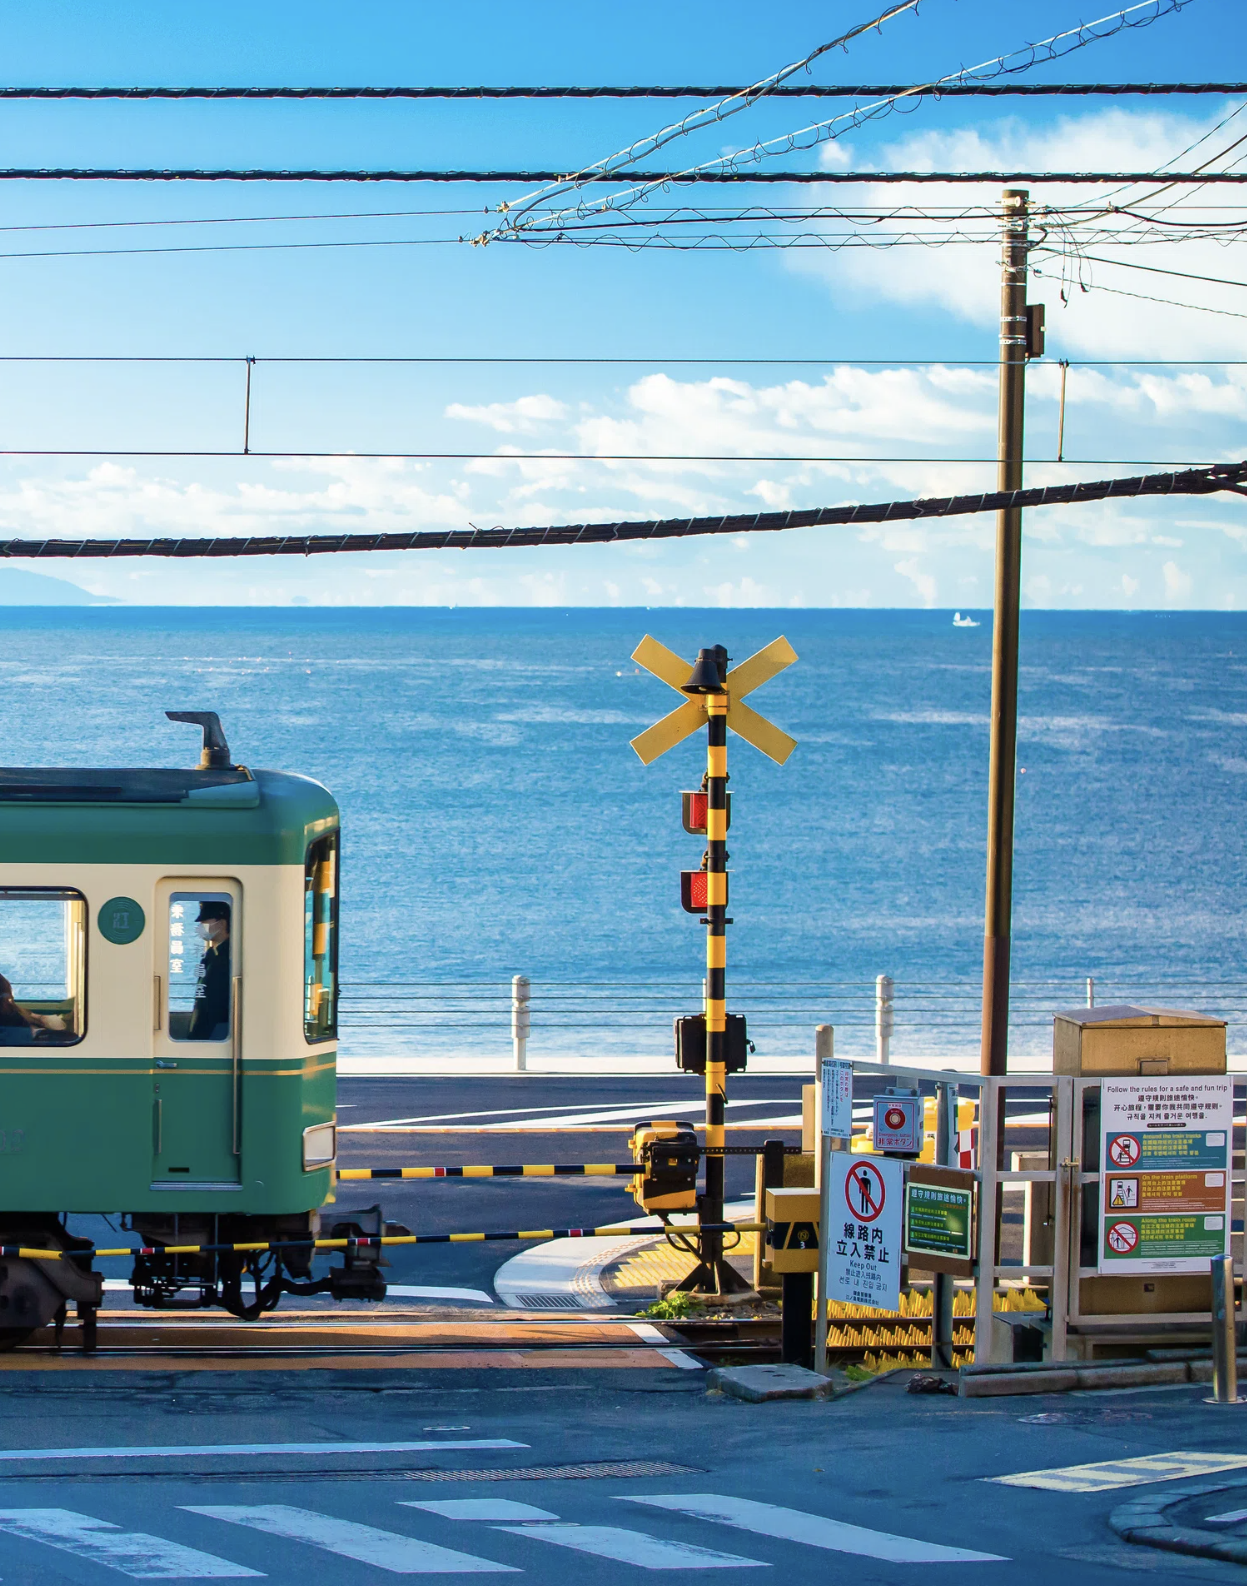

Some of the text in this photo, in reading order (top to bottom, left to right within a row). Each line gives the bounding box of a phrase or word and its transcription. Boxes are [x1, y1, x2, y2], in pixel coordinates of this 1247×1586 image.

[170, 904, 184, 973] 乗務員室
[878, 1138, 913, 1147] 非常ボタン
[843, 1222, 883, 1244] 線路内
[800, 1241, 806, 1249] 3
[836, 1240, 889, 1263] 立入禁止
[850, 1260, 877, 1271] Keep Out
[863, 1280, 874, 1289] 진입
